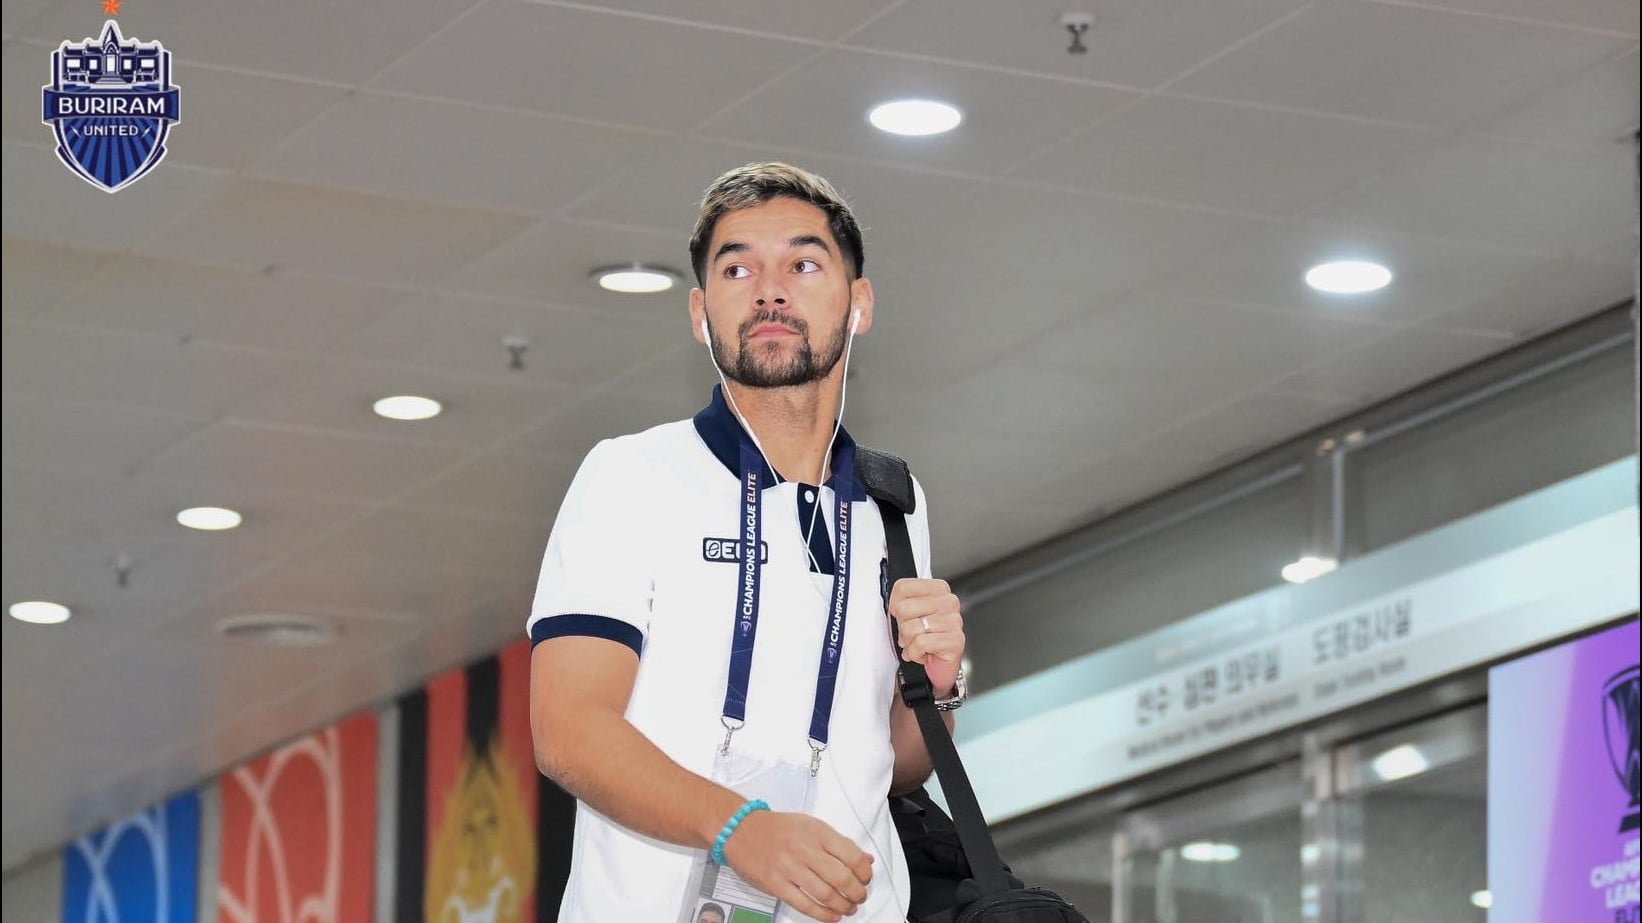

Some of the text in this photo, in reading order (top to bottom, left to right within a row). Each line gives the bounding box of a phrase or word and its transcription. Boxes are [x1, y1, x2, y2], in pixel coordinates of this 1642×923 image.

[747, 472, 757, 503] ELITE
[747, 504, 756, 547] LEAGUE
[839, 501, 850, 531] ELITE
[839, 531, 849, 574] LEAGUE
[743, 548, 756, 616] CHAMPIONS
[830, 574, 846, 643] CHAMPIONS
